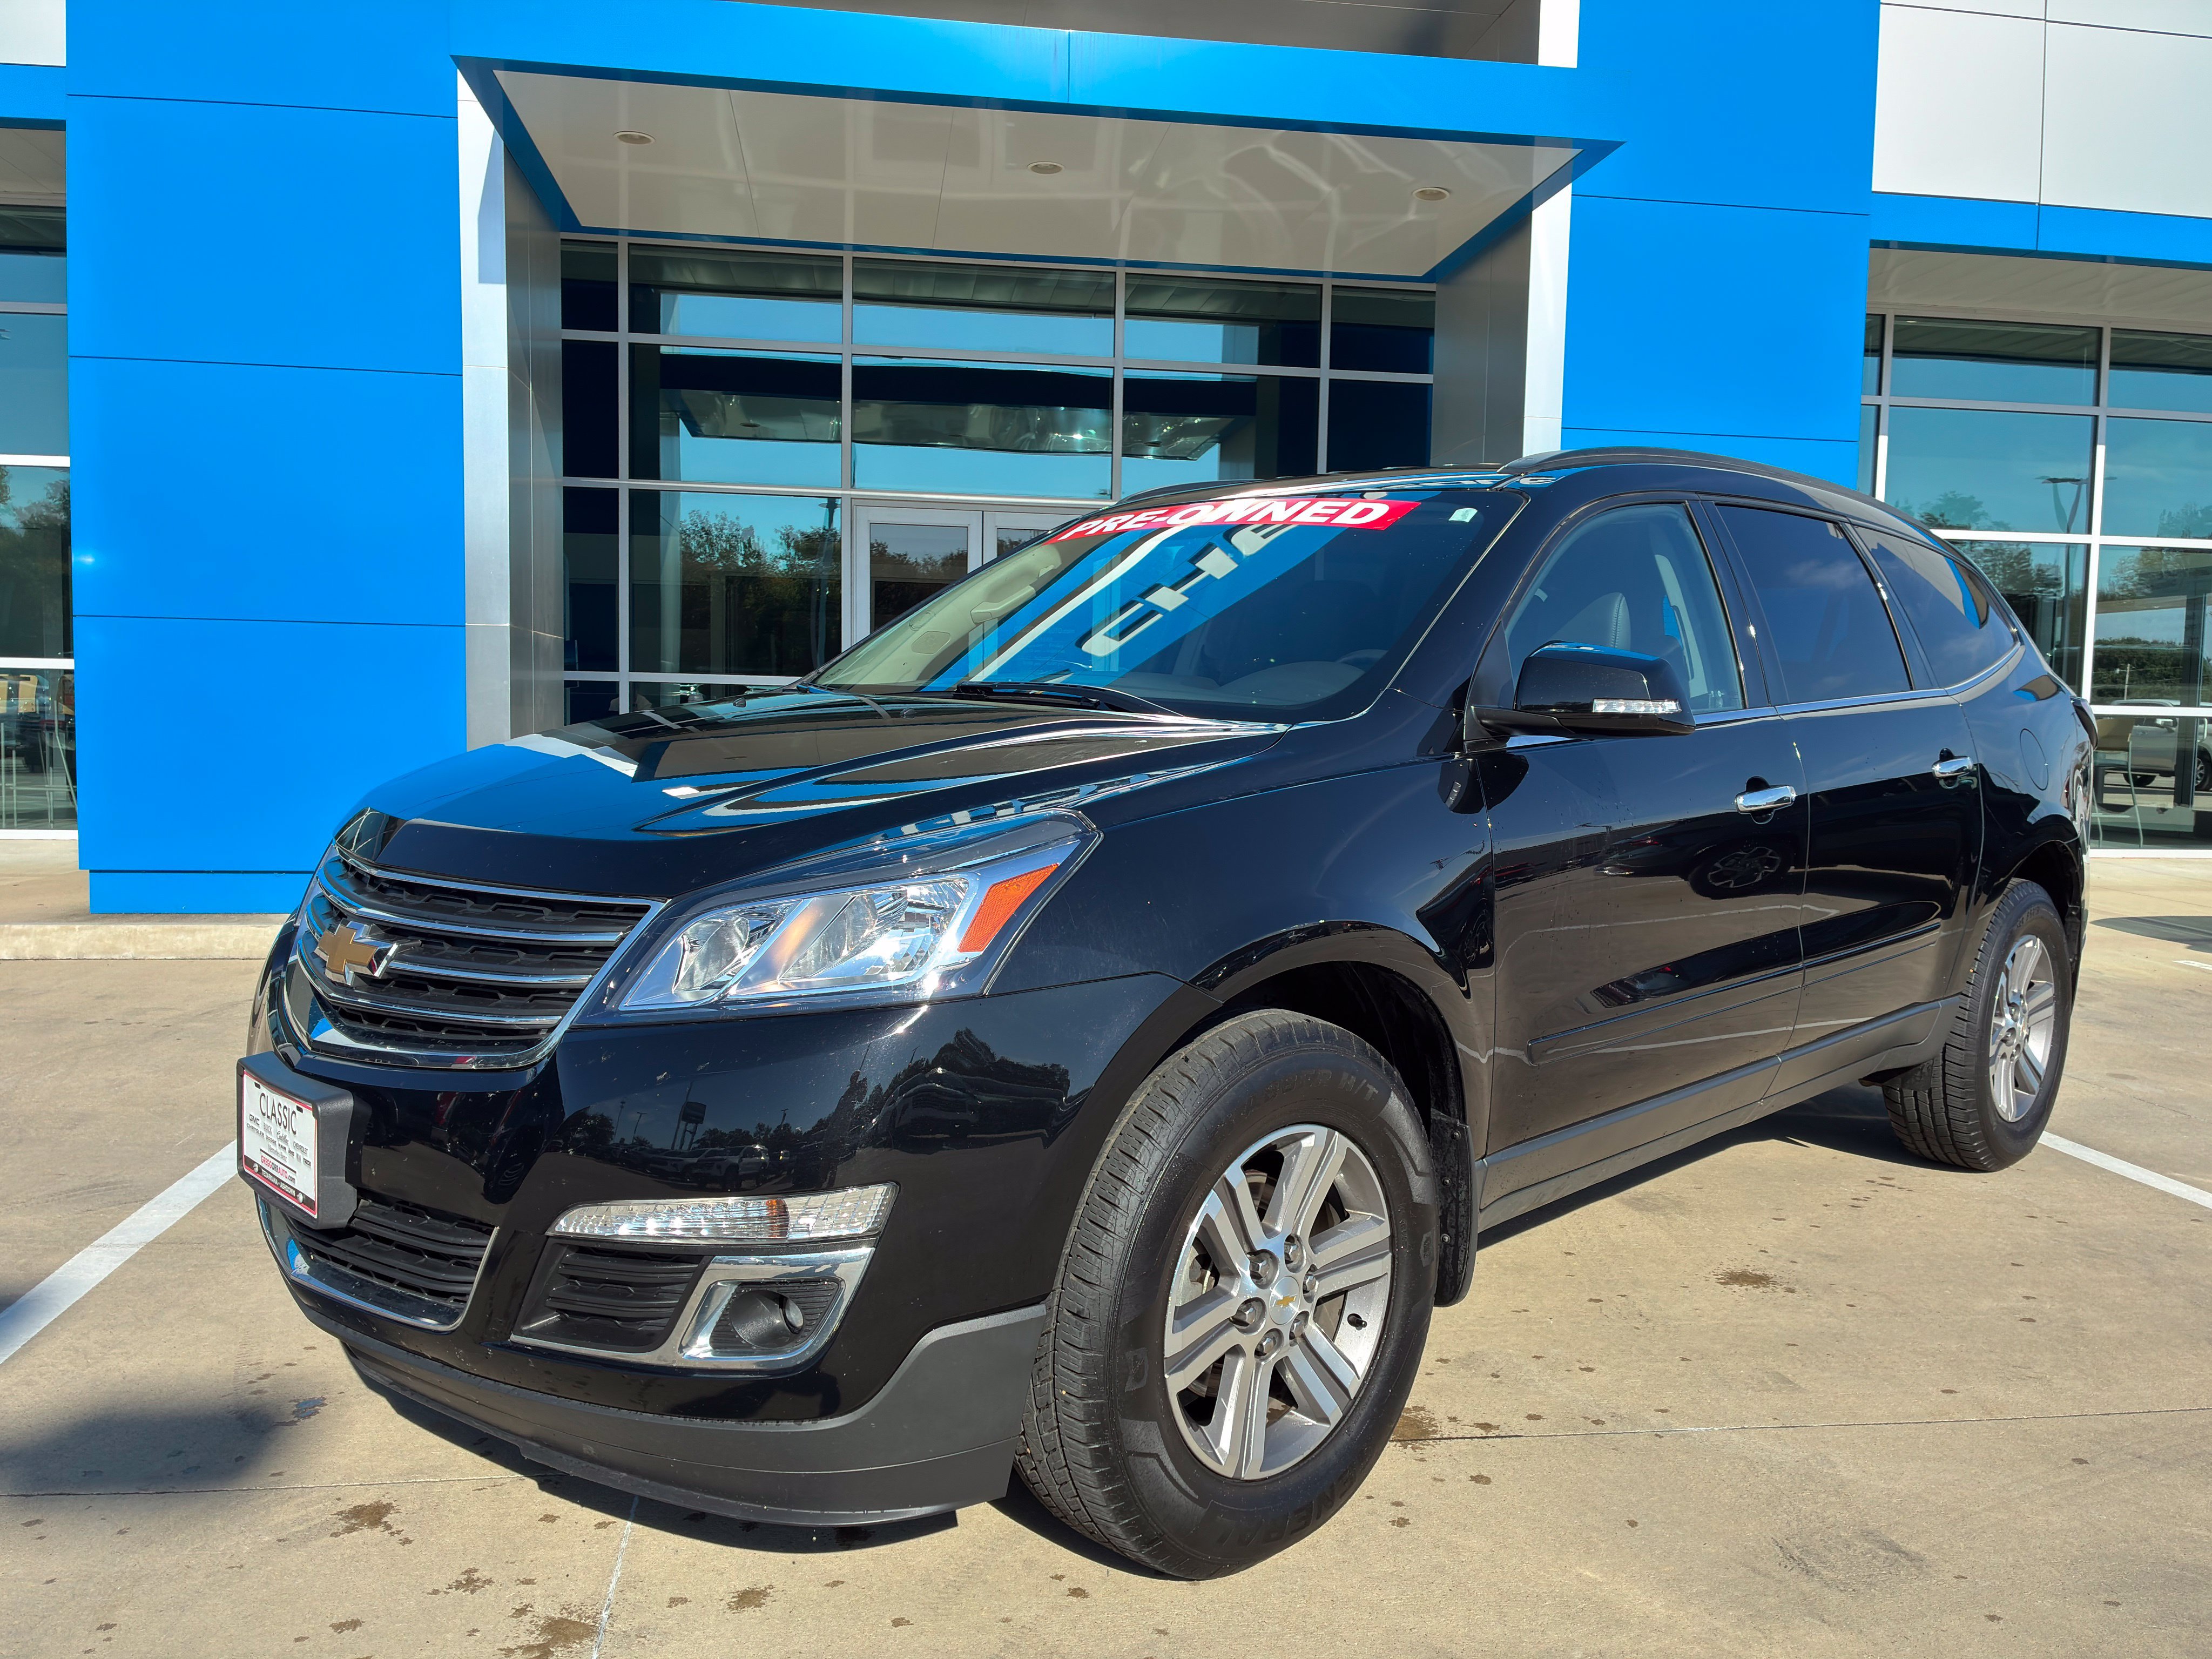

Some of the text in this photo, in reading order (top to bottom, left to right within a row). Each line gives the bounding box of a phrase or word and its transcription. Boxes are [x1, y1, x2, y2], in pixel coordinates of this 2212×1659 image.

[1057, 499, 1390, 541] PRE-OWNED
[260, 1092, 296, 1135] CLASSIC
[247, 1123, 265, 1137] CHRYSLER
[265, 1135, 276, 1144] DODGE
[278, 1143, 287, 1151] RAM
[249, 1114, 308, 1154] GMC BUICK Cadillac CHEVROLET
[268, 1144, 287, 1162] Mercedes-Benz
[261, 1155, 296, 1184] GREGGORRAUTO.com
[261, 1168, 296, 1197] TEXARKANA ASHDOWN
